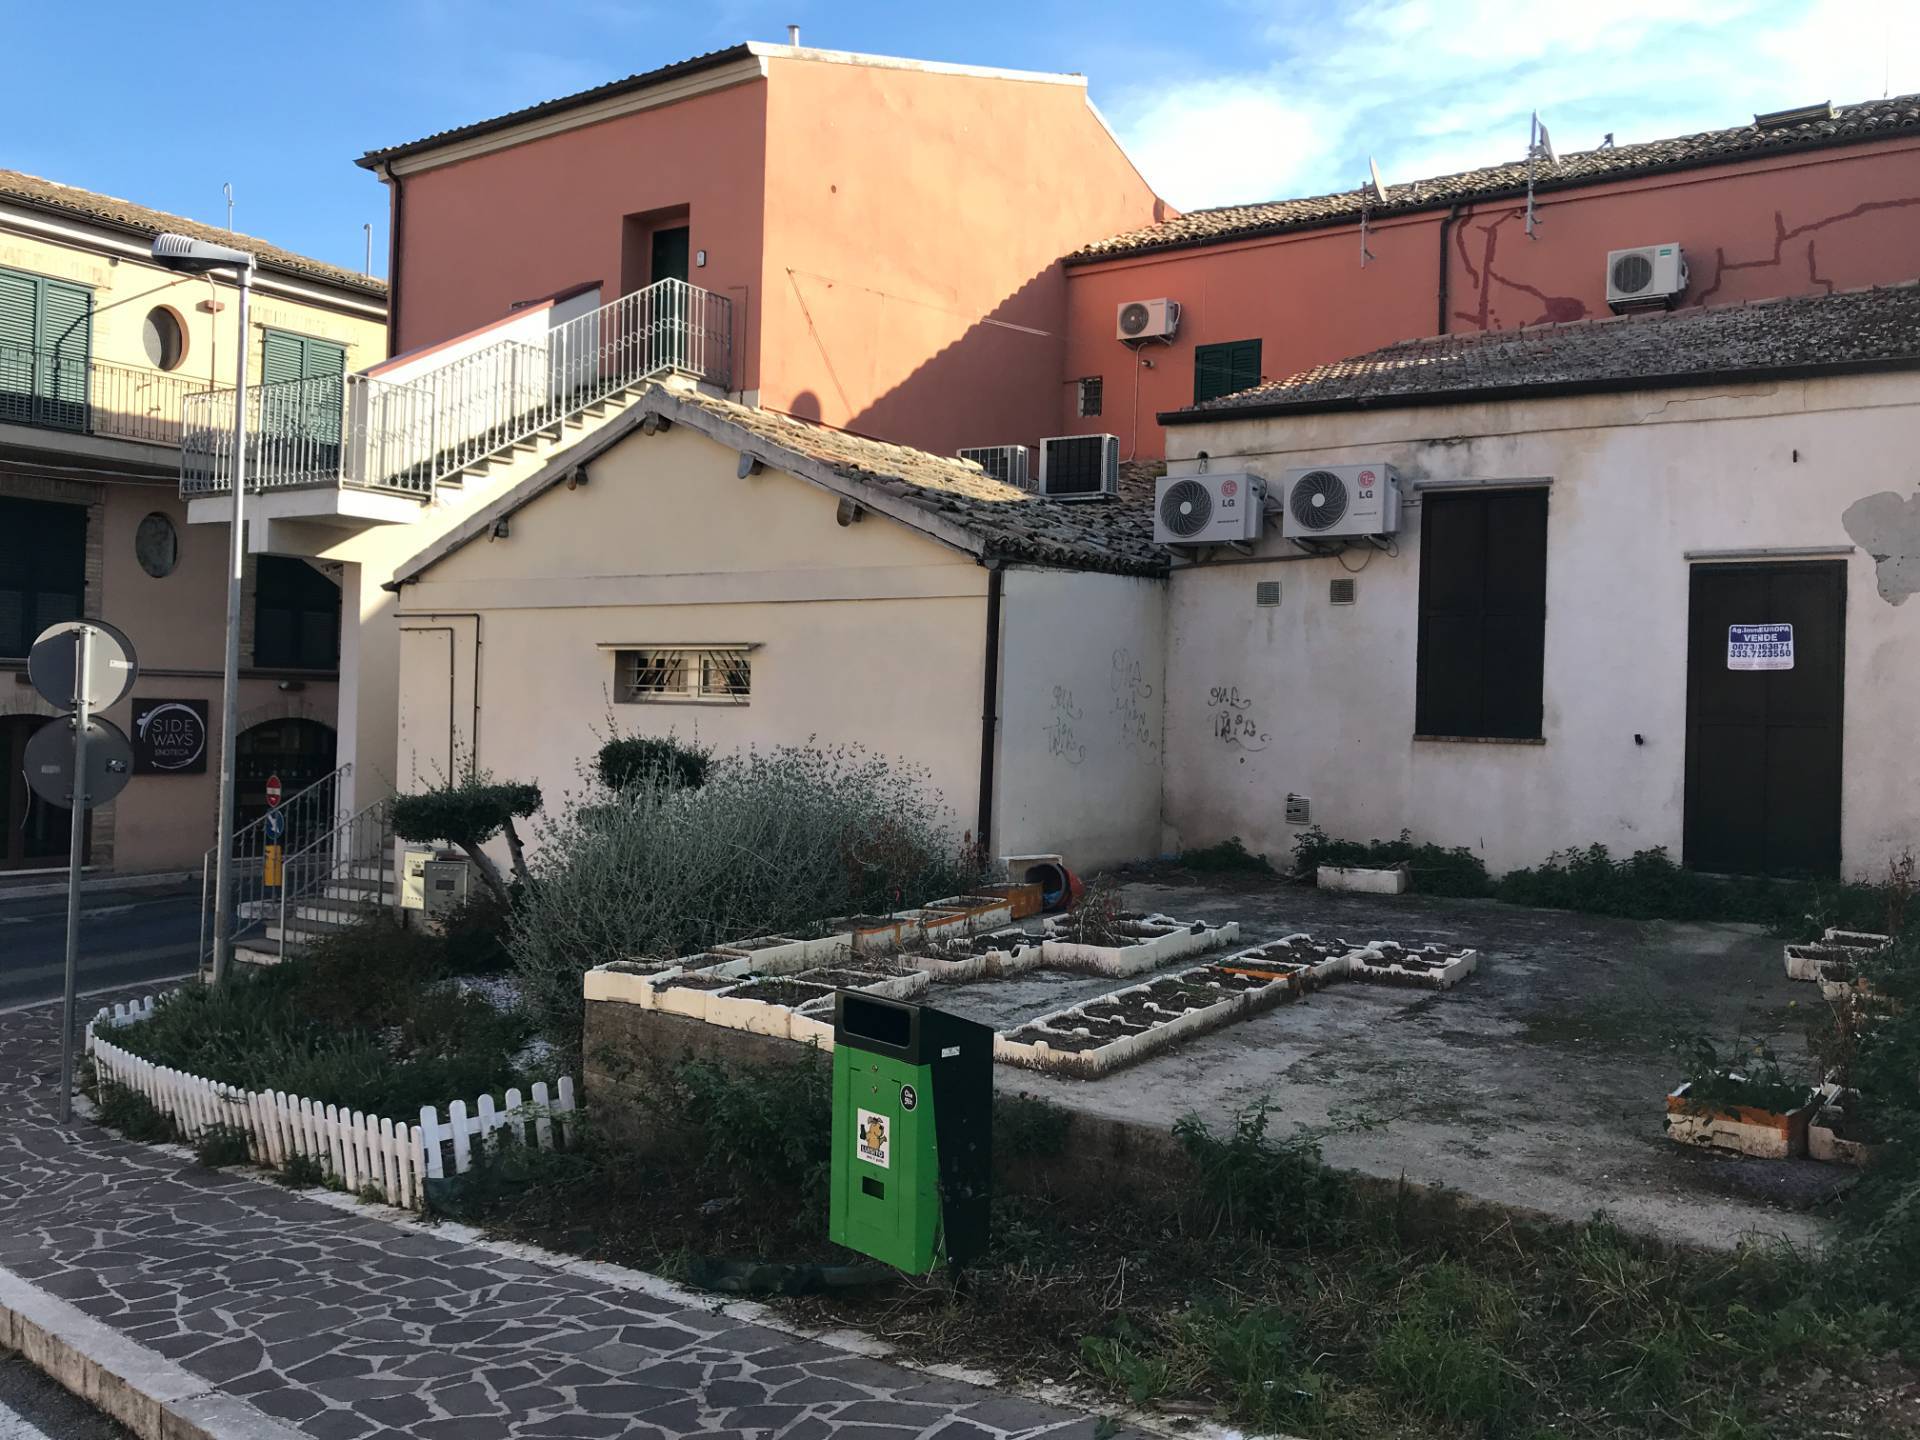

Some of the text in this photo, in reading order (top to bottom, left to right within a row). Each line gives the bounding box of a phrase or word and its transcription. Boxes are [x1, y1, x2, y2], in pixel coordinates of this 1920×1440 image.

[1359, 490, 1373, 498] LG
[1222, 499, 1235, 507] LG
[1744, 634, 1778, 642] VENDE
[152, 719, 193, 732] SIDE
[152, 733, 193, 746] WAYS
